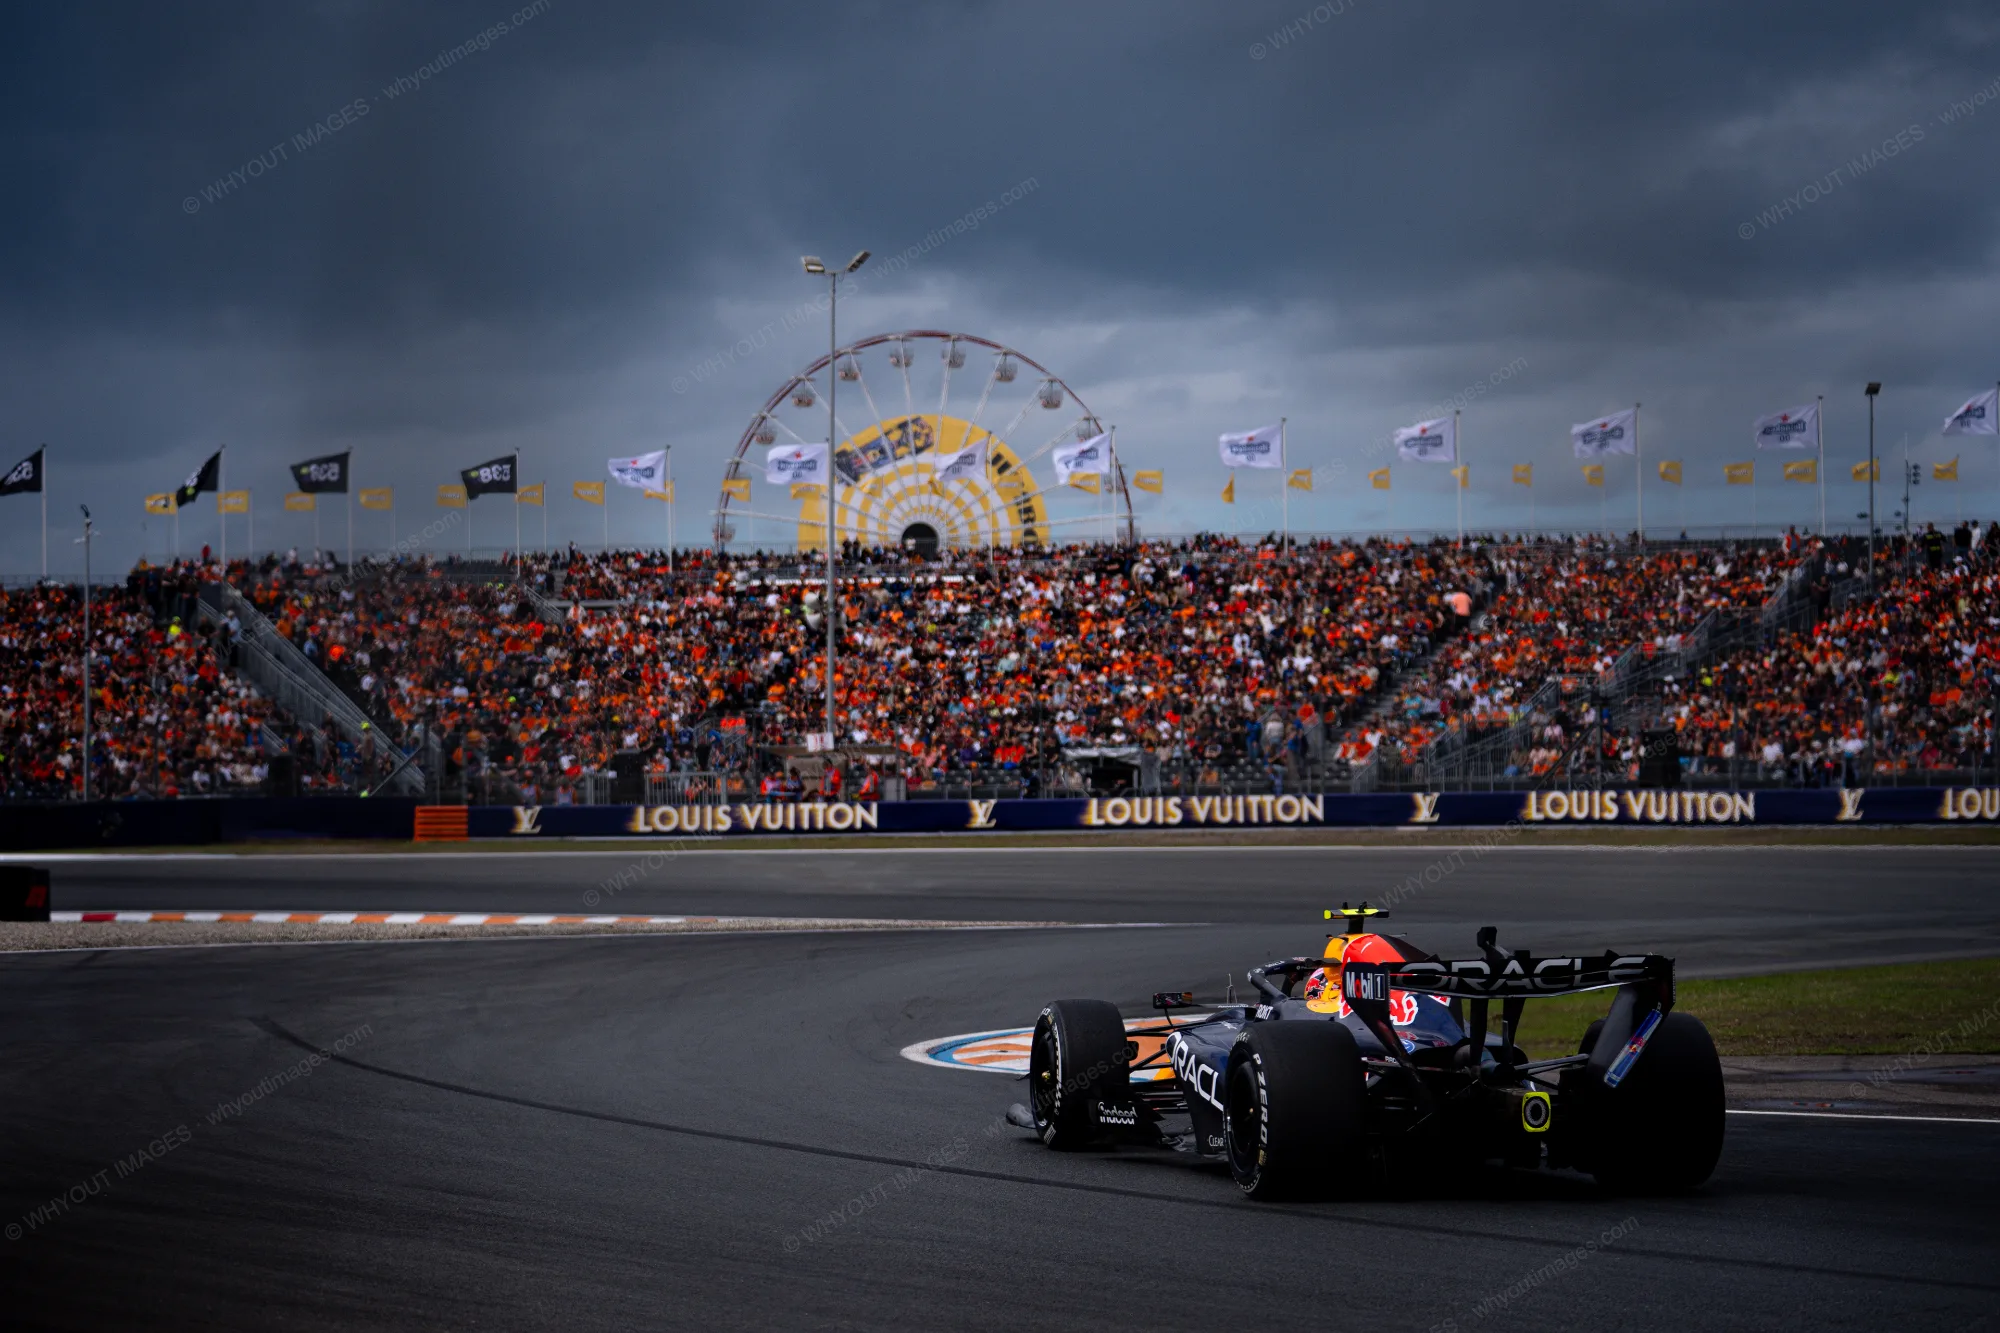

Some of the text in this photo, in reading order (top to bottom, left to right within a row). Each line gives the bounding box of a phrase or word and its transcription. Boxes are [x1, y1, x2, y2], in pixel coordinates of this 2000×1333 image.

[635, 802, 878, 832] LOUIS VUITTON
[1086, 794, 1324, 826] LOUIS VUITTON
[1527, 790, 1755, 822] LOUIS VUITTON
[1346, 971, 1373, 1000] Mobil
[1396, 957, 1646, 991] ORACLE
[1166, 1032, 1224, 1111] ORACL
[1257, 1071, 1268, 1145] ZERO
